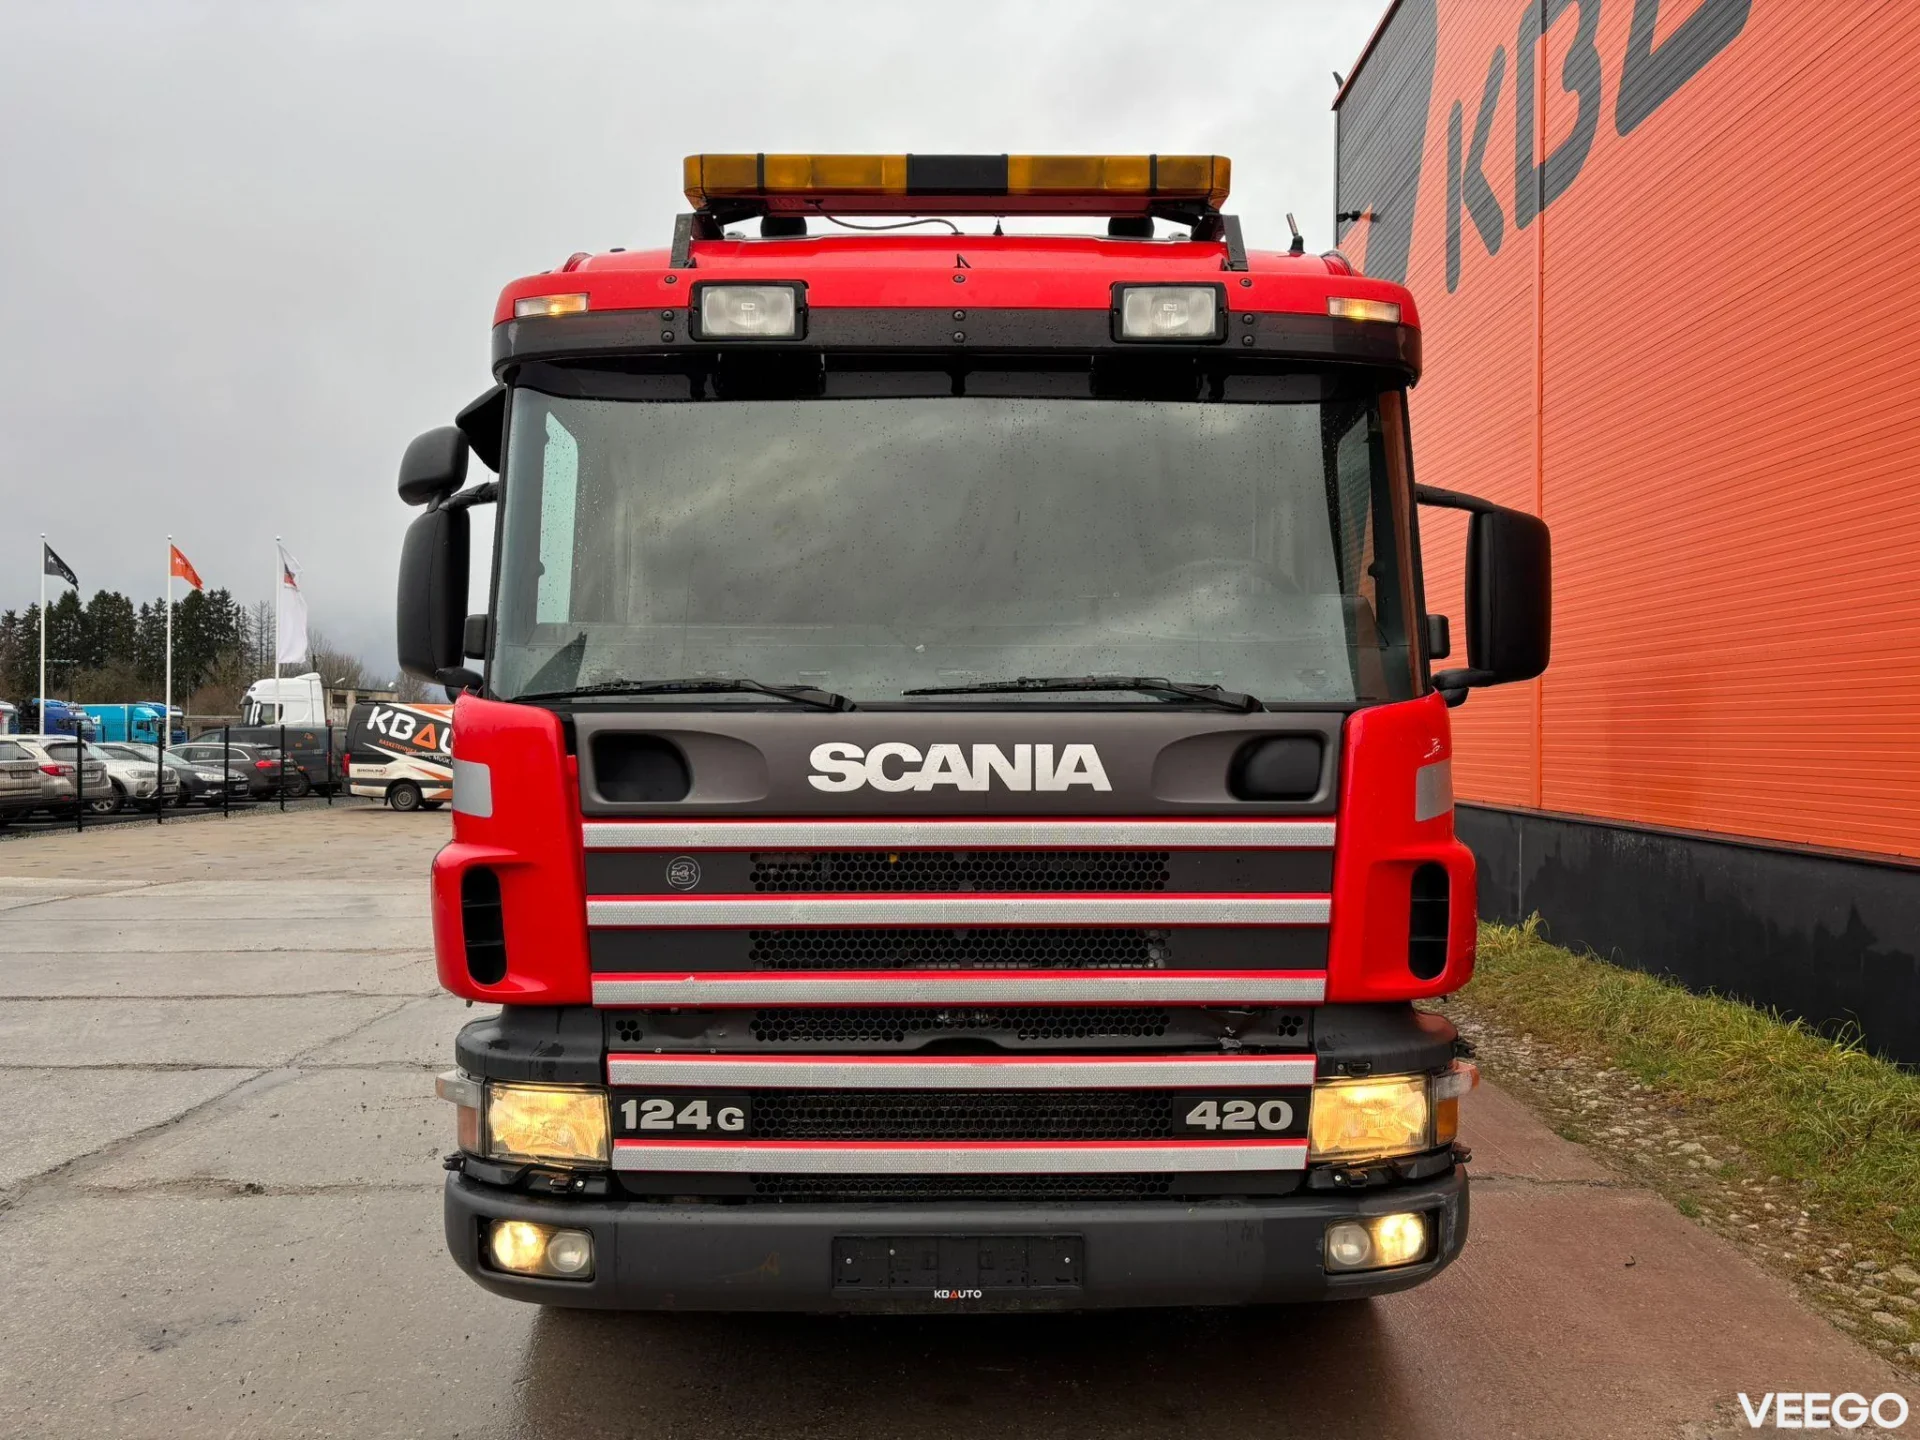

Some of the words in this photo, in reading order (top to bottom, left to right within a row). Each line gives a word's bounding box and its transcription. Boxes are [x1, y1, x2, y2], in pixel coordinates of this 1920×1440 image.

[808, 742, 1113, 793] SCANIA
[1185, 1100, 1294, 1131] 420
[933, 1289, 983, 1299] KBAUTO
